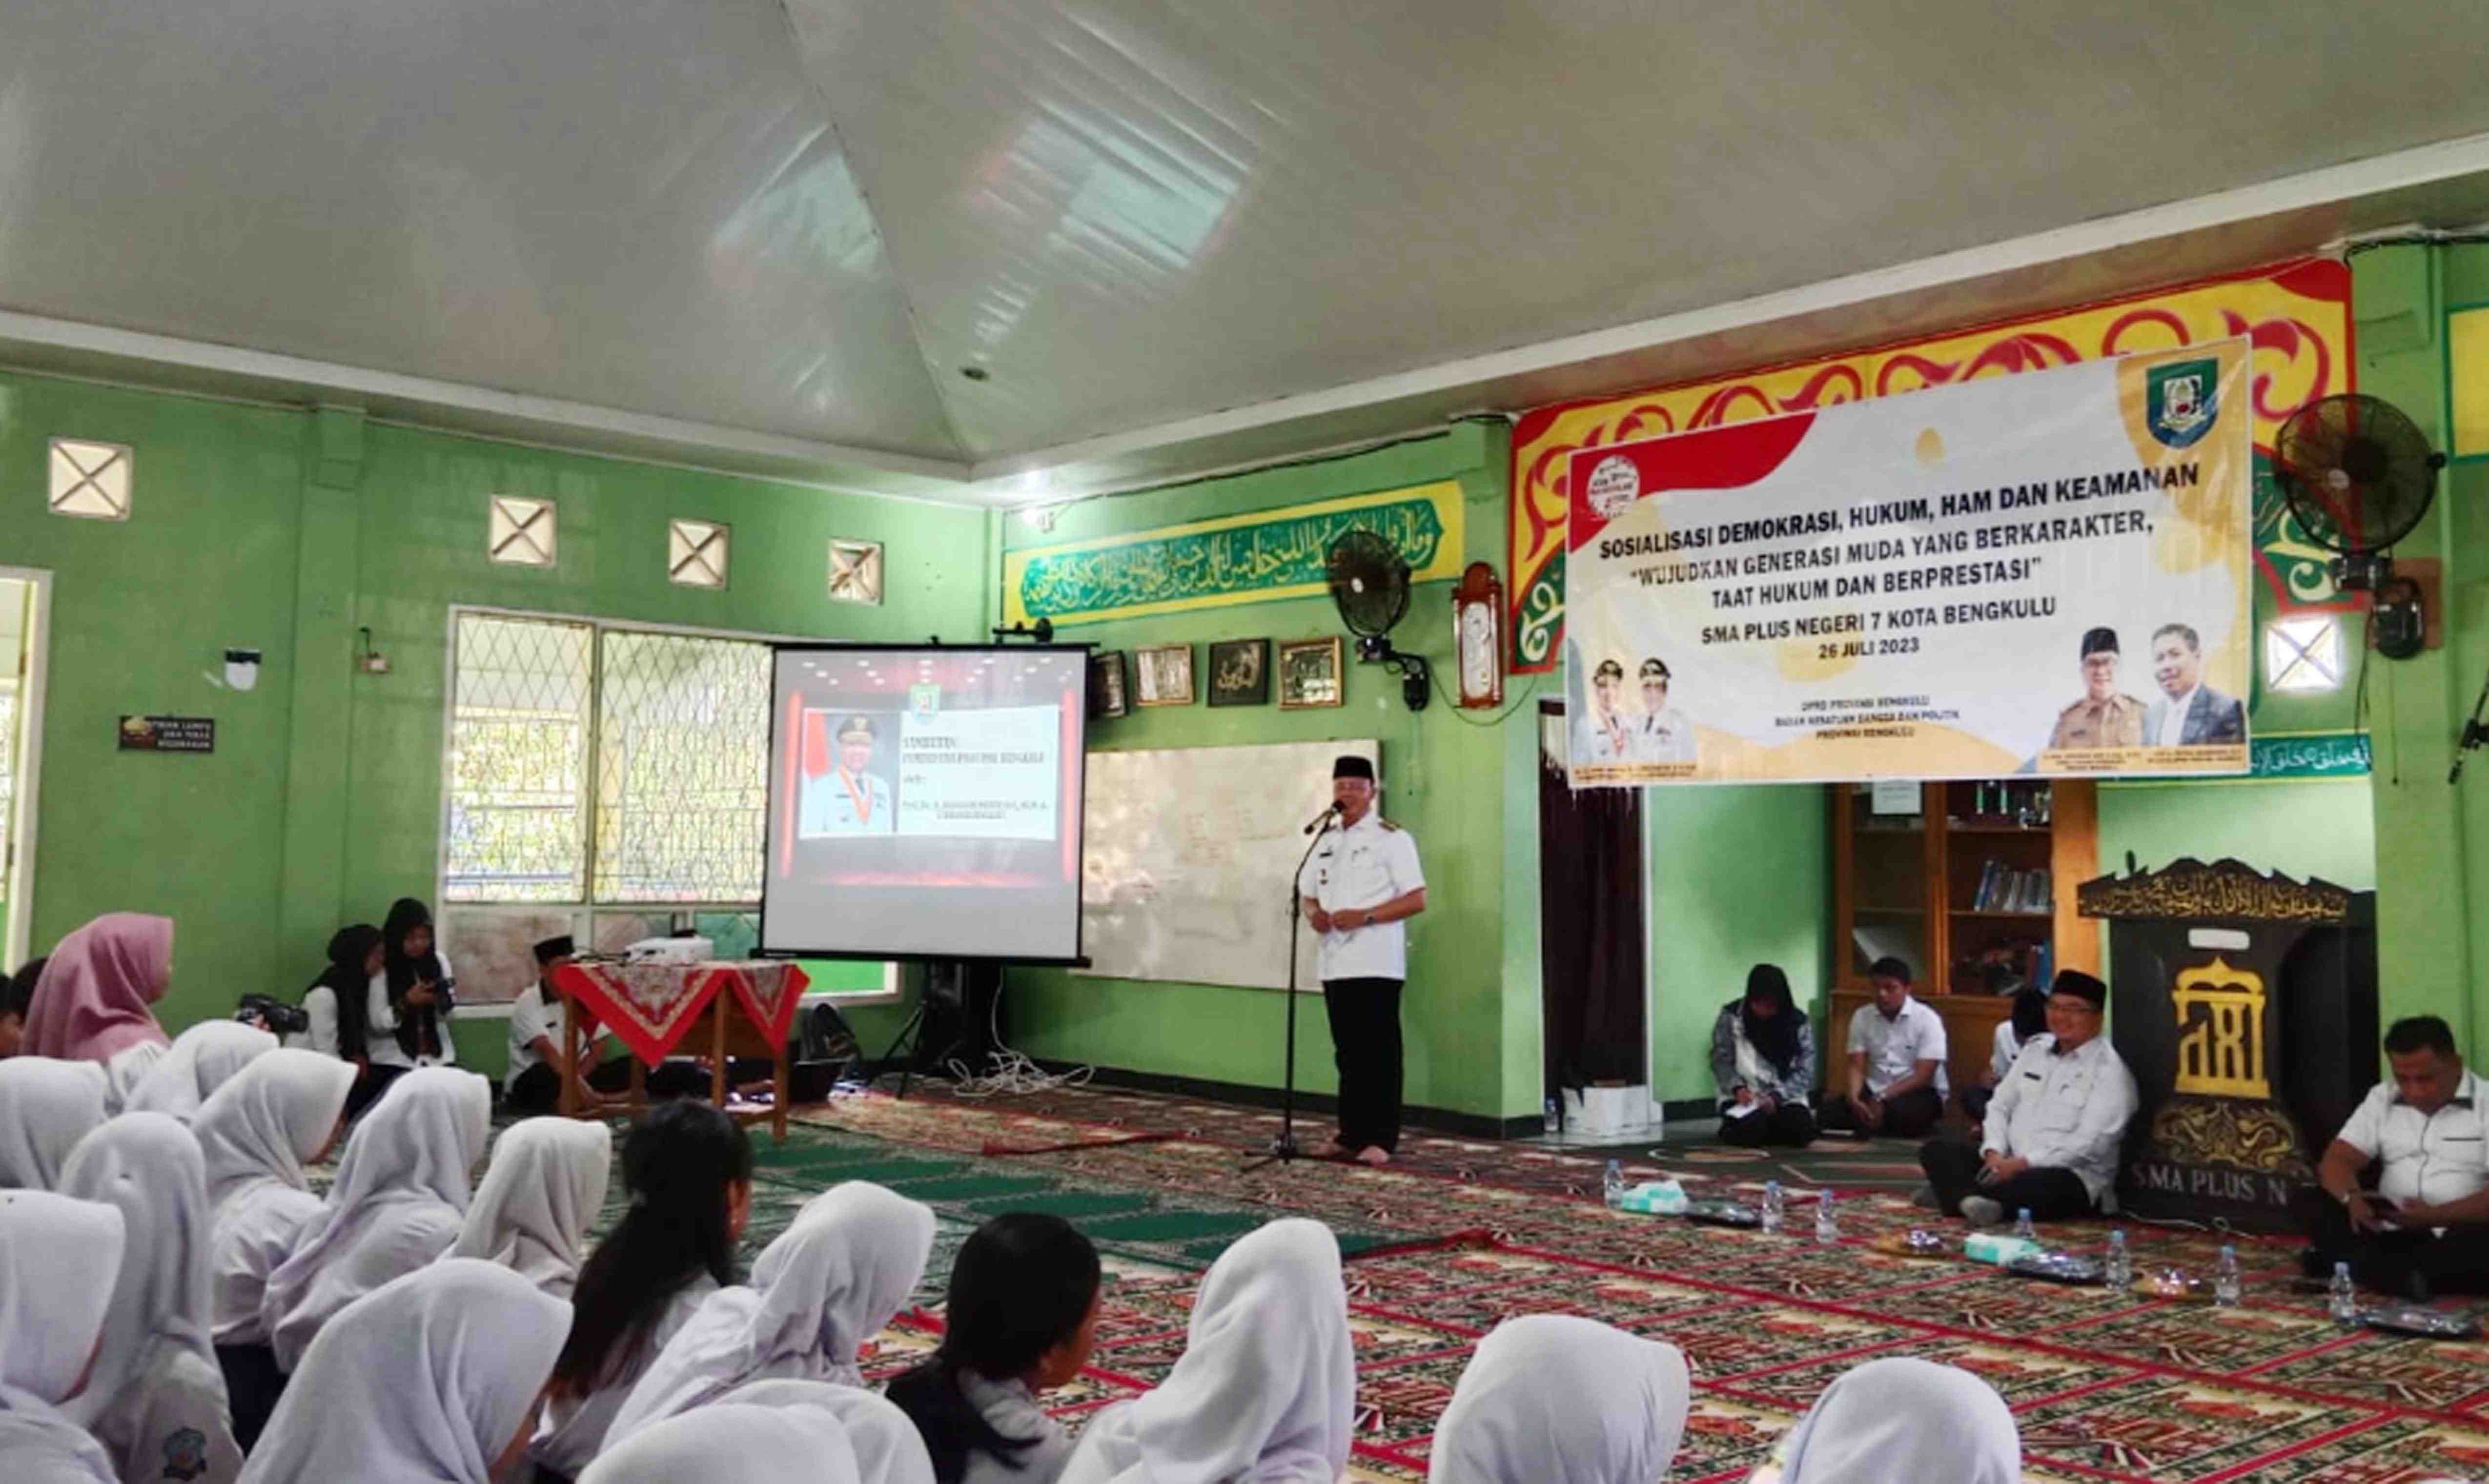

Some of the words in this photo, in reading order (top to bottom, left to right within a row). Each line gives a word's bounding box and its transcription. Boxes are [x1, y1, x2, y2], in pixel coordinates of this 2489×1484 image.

[1599, 526, 1713, 560] SOSIALISASI
[1718, 509, 1843, 545] DEMOKRASI,
[1849, 498, 1935, 528] HUKUM,
[1940, 489, 1992, 517] HAM
[1999, 482, 2048, 509] DAN
[2055, 463, 2199, 503] KEAMANAN
[1744, 546, 1840, 575] GENERASI
[1846, 537, 1905, 565] MUDA
[1912, 531, 1968, 556] YANG
[1975, 510, 2153, 550] BERKARAKTER,
[1712, 587, 1753, 610] TAAT
[1759, 579, 1828, 606] HUKUM
[1836, 575, 1876, 597] DAN
[1702, 626, 1740, 645] SMA
[1744, 620, 1790, 641] PLUS
[1795, 613, 1865, 637] NEGERI
[1870, 611, 1881, 630] 7
[1887, 606, 1938, 629] KOTA
[1944, 596, 2057, 625] BENGKULU
[1818, 643, 1837, 660] 26
[1840, 641, 1875, 658] JULI
[1879, 637, 1920, 655] 2023
[2131, 1163, 2184, 1192] SMA
[2191, 1169, 2256, 1202] PLUS
